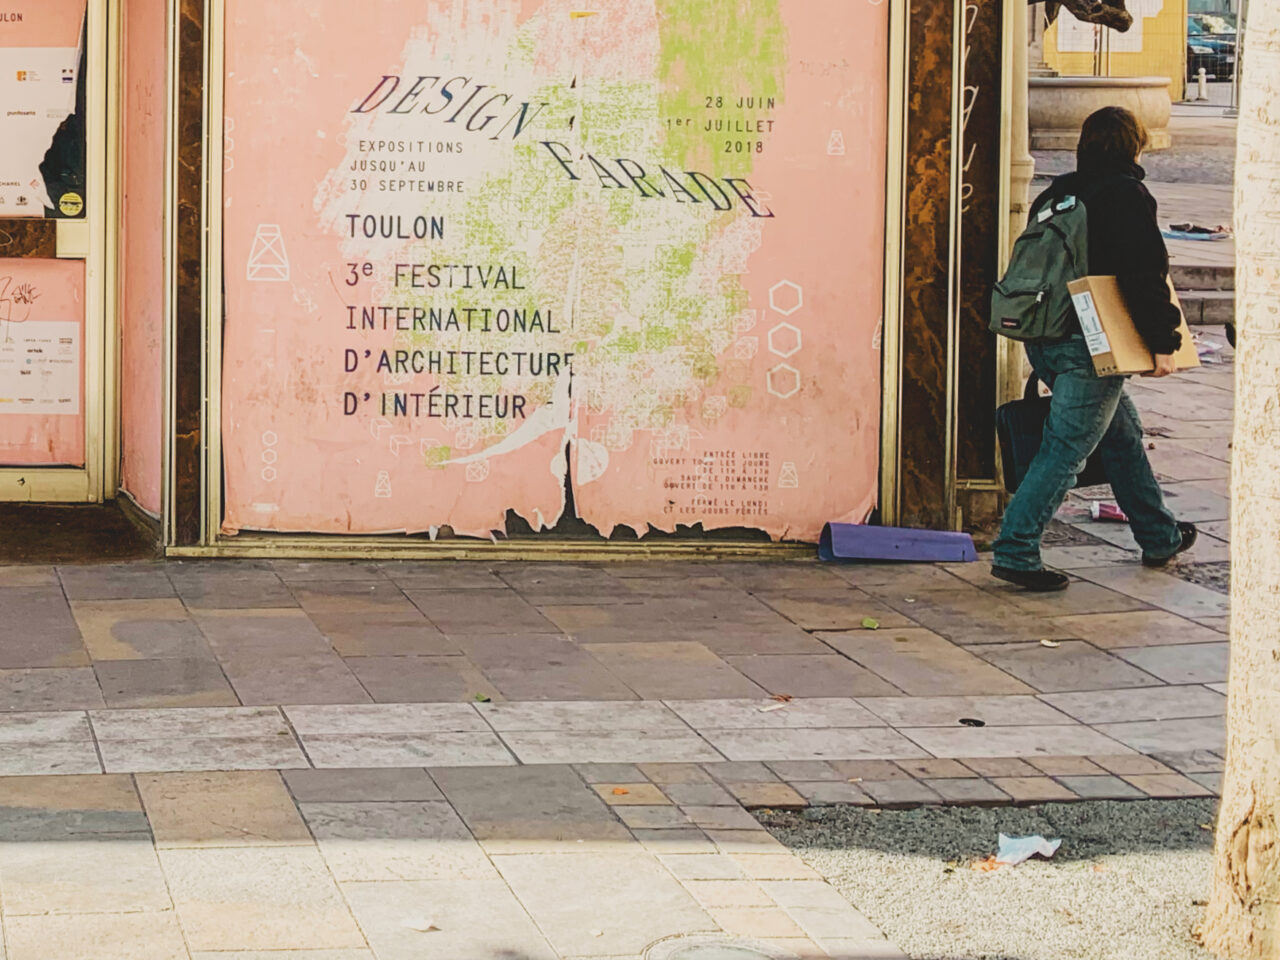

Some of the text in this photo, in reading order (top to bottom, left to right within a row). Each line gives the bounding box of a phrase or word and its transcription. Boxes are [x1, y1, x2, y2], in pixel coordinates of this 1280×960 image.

[350, 75, 549, 140] DESIGN
[705, 96, 775, 109] 28 JUIN
[704, 119, 775, 133] JUILLET
[358, 140, 463, 154] EXPOSITIONS
[724, 141, 764, 154] 2018
[350, 160, 426, 172] JUSQU'AU
[350, 179, 465, 193] 30 SEPTEMBRE
[538, 141, 775, 218] PARADE
[345, 214, 444, 240] TOULON
[345, 262, 526, 290] 3e FESTIVAL
[345, 306, 561, 334] INTERNATIONAL
[343, 385, 527, 419] D'INTÉRIEUR
[703, 450, 770, 459] ENTRÉE LIBRE
[725, 475, 769, 483] DIMANCHE
[663, 506, 673, 514] ET
[679, 506, 696, 514] LES
